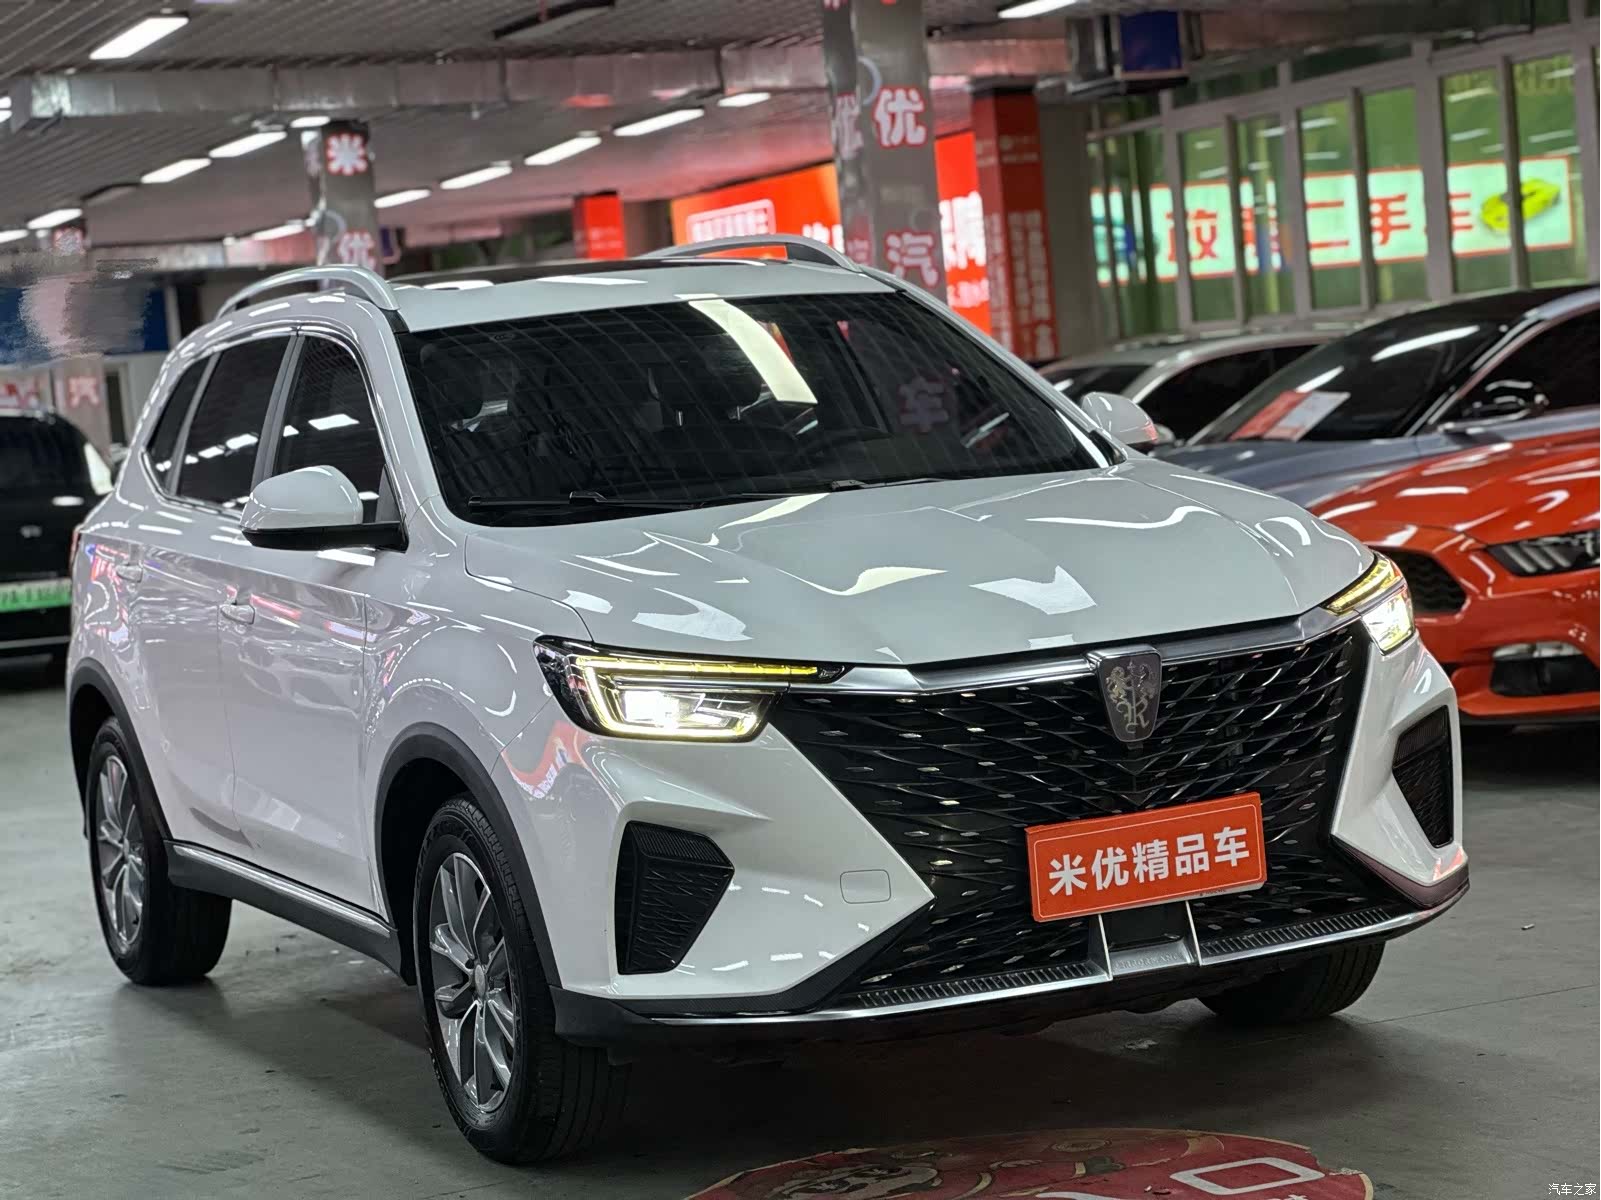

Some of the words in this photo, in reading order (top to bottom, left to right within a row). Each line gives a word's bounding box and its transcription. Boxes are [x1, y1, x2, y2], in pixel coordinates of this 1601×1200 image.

[1164, 190, 1474, 264] 放二手
[1048, 826, 1250, 896] 米优精品车
